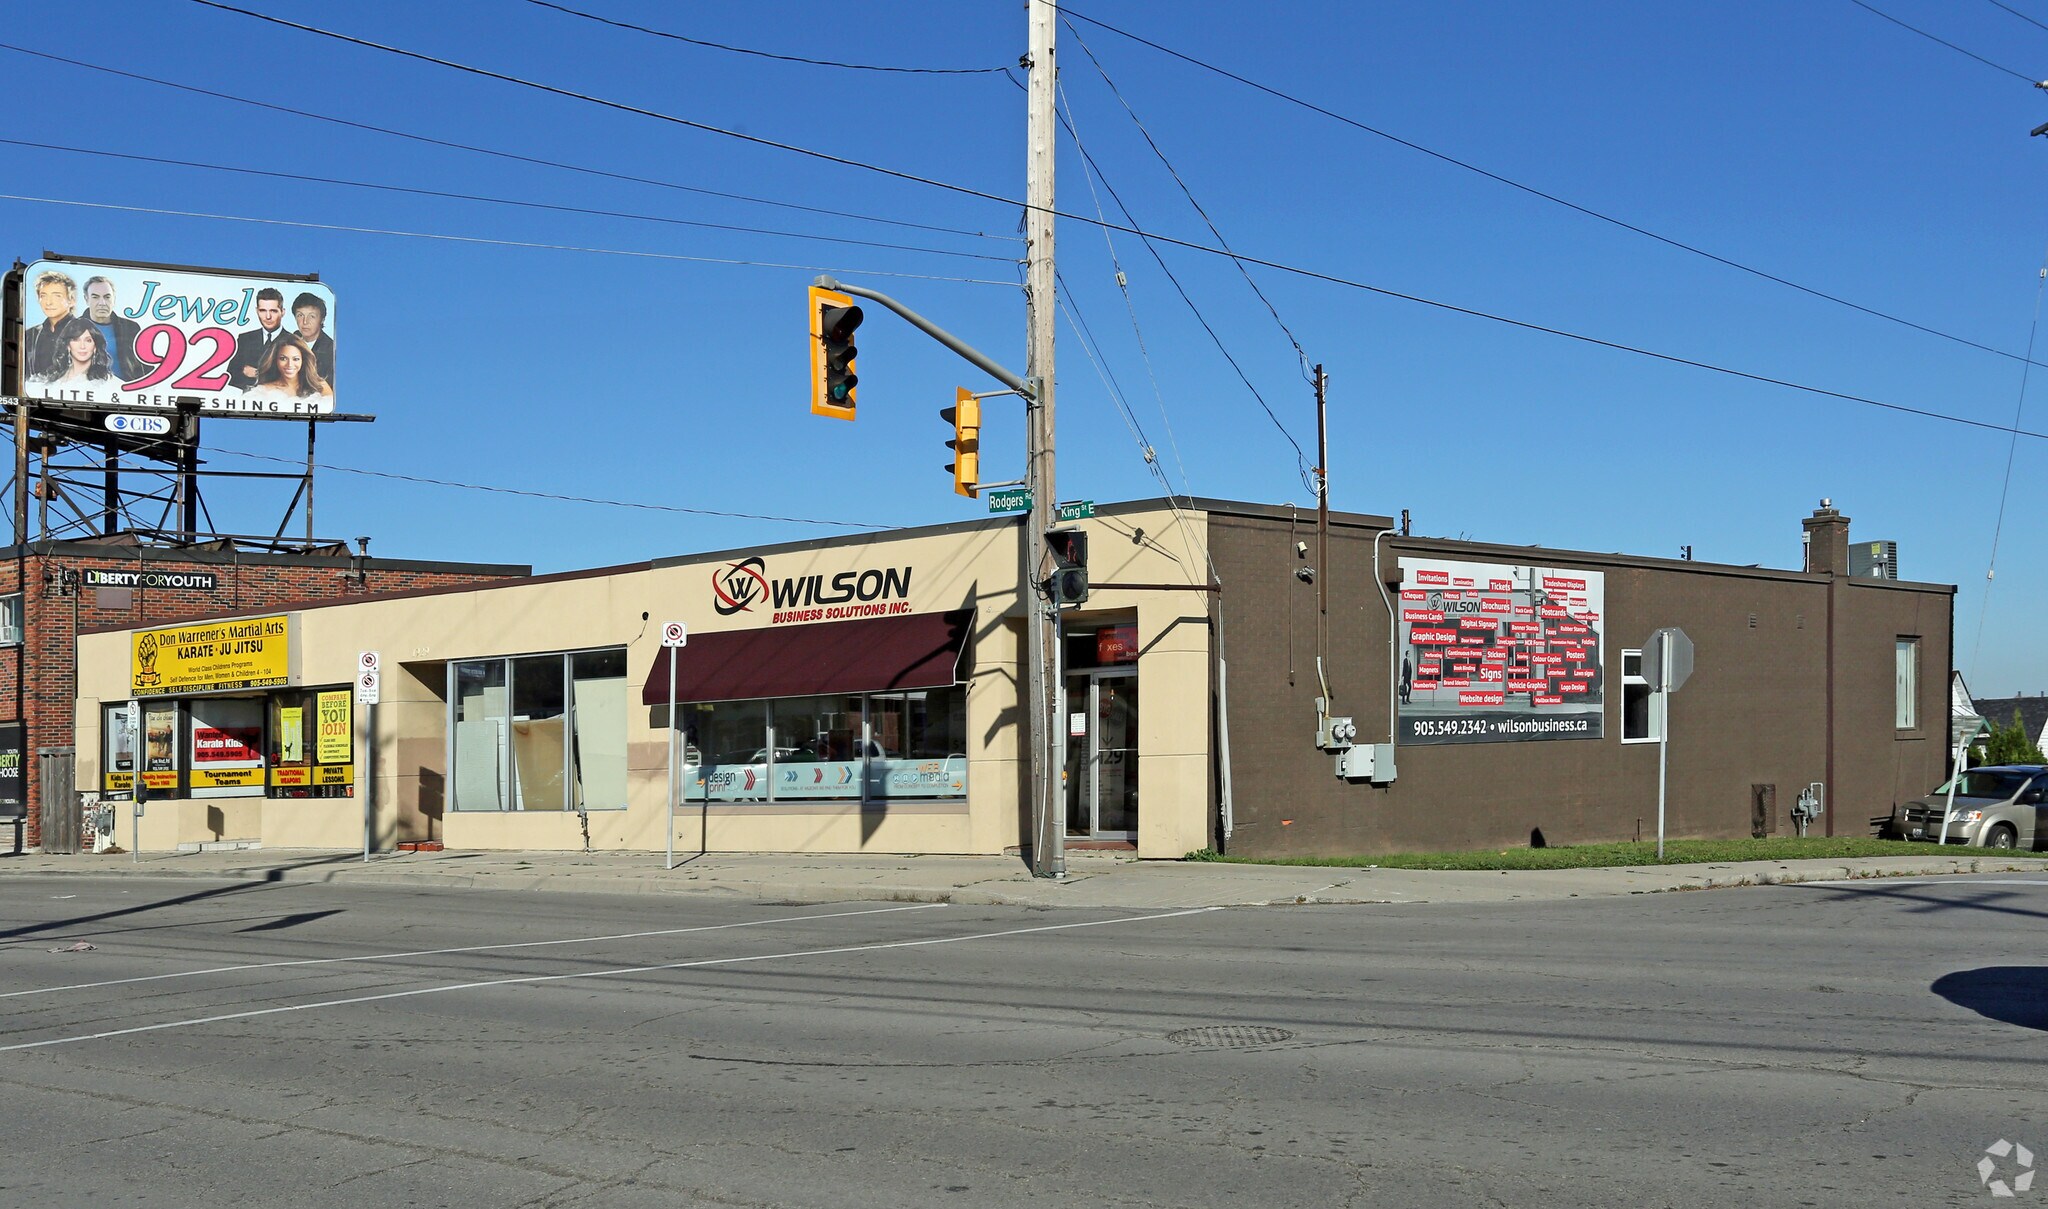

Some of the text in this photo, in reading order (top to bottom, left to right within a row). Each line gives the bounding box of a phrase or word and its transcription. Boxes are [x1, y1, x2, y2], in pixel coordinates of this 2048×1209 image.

[125, 280, 255, 326] Jewel
[121, 323, 237, 392] 92
[44, 388, 318, 414] LITE & REFESHING FM
[130, 416, 163, 432] CBS
[990, 496, 1024, 510] Rodgers
[1061, 506, 1080, 518] King
[1088, 503, 1094, 514] E
[1418, 573, 1448, 583] Invitations
[728, 576, 754, 600] W
[772, 566, 912, 609] WILSON
[1490, 582, 1511, 591] Tickets
[1404, 592, 1424, 600] Cheques
[1443, 601, 1481, 612] WILSON
[1482, 602, 1510, 611] Brochures
[772, 601, 912, 624] BUSINESS SOLUTIONS INC.
[1542, 608, 1567, 617] Postcards
[1478, 620, 1498, 628] Signage
[159, 621, 284, 646] Don Warrener's Martial Arts
[1411, 632, 1457, 642] Graphic Design
[177, 640, 263, 660] KARATE JU JITSU
[1566, 651, 1585, 659] Posters
[1547, 656, 1562, 664] Copies
[235, 669, 256, 677] Children
[1418, 666, 1439, 674] Magnets
[1480, 668, 1502, 682] Signs
[133, 687, 166, 696] CONFIDENCE
[183, 684, 215, 692] DISCIPLINE
[218, 682, 243, 690] FITNESS
[250, 678, 287, 687] 905-549-5905
[1526, 682, 1547, 690] Graphics
[321, 700, 347, 709] BEFORE
[1460, 694, 1503, 704] Website design
[321, 709, 347, 723] YOU
[321, 723, 347, 735] JOIN
[1414, 719, 1588, 736] 905.549.2342 wilsonbusiness.ca
[197, 731, 224, 739] Wanted
[196, 738, 244, 749] Karate Kids
[204, 770, 252, 778] Tournament
[323, 767, 344, 775] PRIVATE
[322, 775, 345, 784] LESSONS
[708, 770, 736, 786] design
[920, 772, 950, 782] media
[709, 783, 726, 794] print
